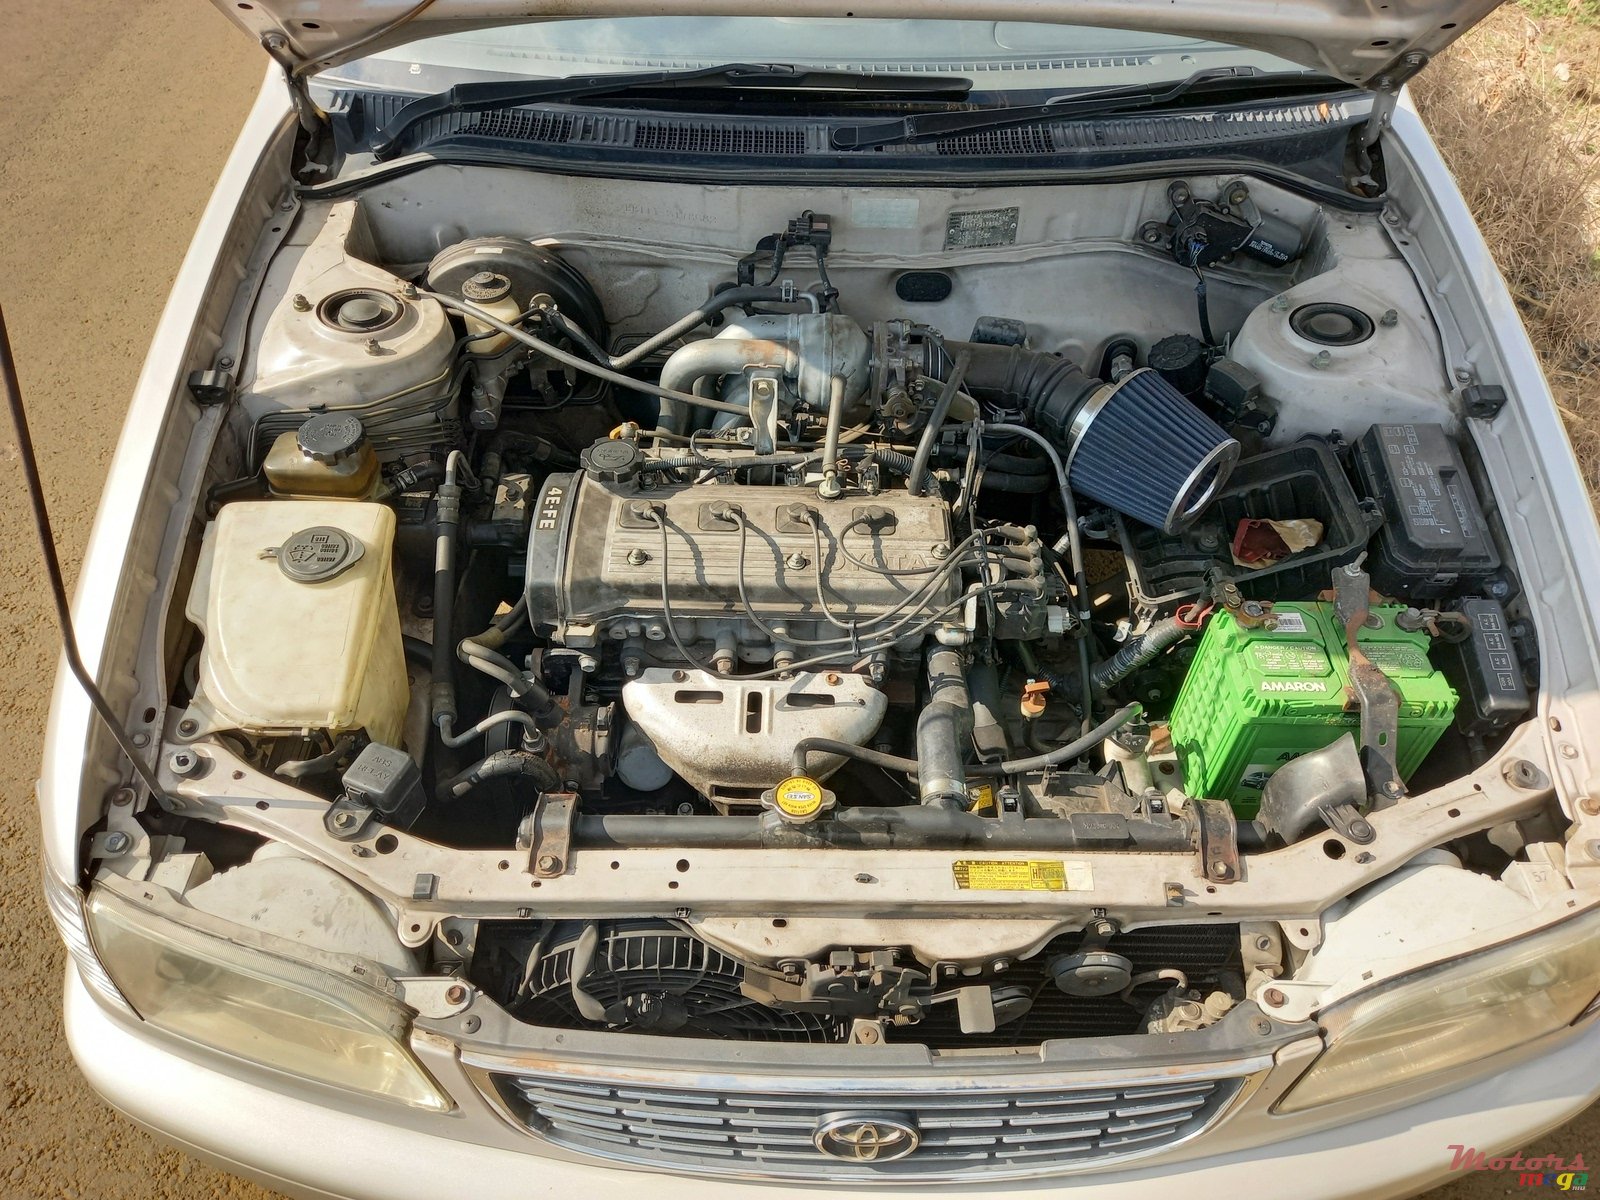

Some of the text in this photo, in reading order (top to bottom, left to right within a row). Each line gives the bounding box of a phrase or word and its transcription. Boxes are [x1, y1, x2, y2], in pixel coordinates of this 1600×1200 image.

[539, 487, 563, 529] 4E-FE
[805, 552, 928, 572] TOYOTA
[1261, 681, 1327, 692] AMARON
